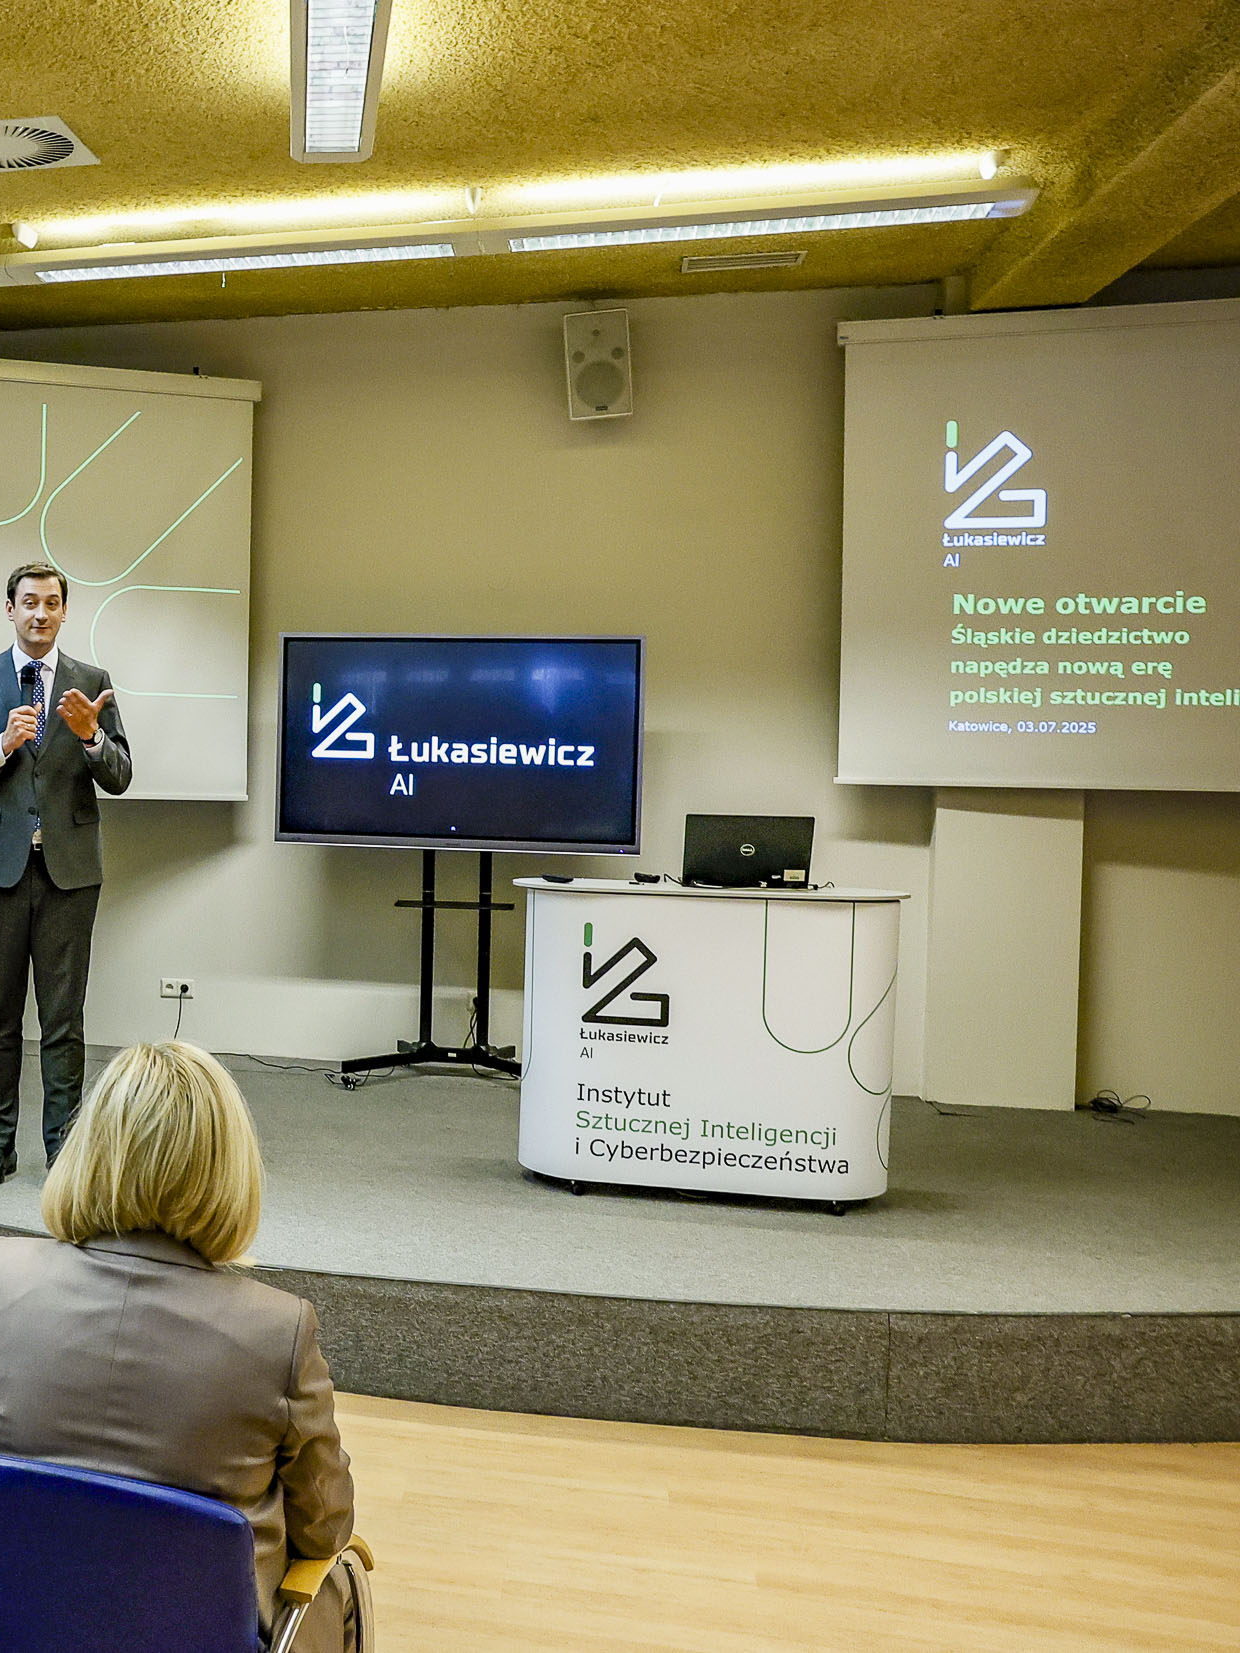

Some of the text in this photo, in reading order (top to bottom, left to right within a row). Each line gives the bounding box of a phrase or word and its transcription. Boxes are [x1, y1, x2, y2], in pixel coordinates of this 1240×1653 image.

[942, 531, 1046, 547] Łukasiewicz
[943, 553, 960, 567] AI
[952, 590, 1207, 615] Nowe otwarcie
[951, 624, 1190, 648] Śląskie dziedzictwo
[950, 658, 1173, 679] napędza nową erę
[949, 687, 1042, 707] polskiej
[1049, 689, 1166, 709] sztucznej
[948, 720, 1096, 734] Katowice, 03.07.2025
[388, 735, 595, 766] Łukasiewicz
[389, 773, 414, 796] AI
[580, 1028, 669, 1045] Łukasiewicz
[580, 1047, 593, 1059] AI
[577, 1083, 671, 1108] Instytut
[575, 1111, 837, 1149] Sztucznej Inteligencji
[575, 1137, 849, 1174] i Cyberbezpieczeństwa
